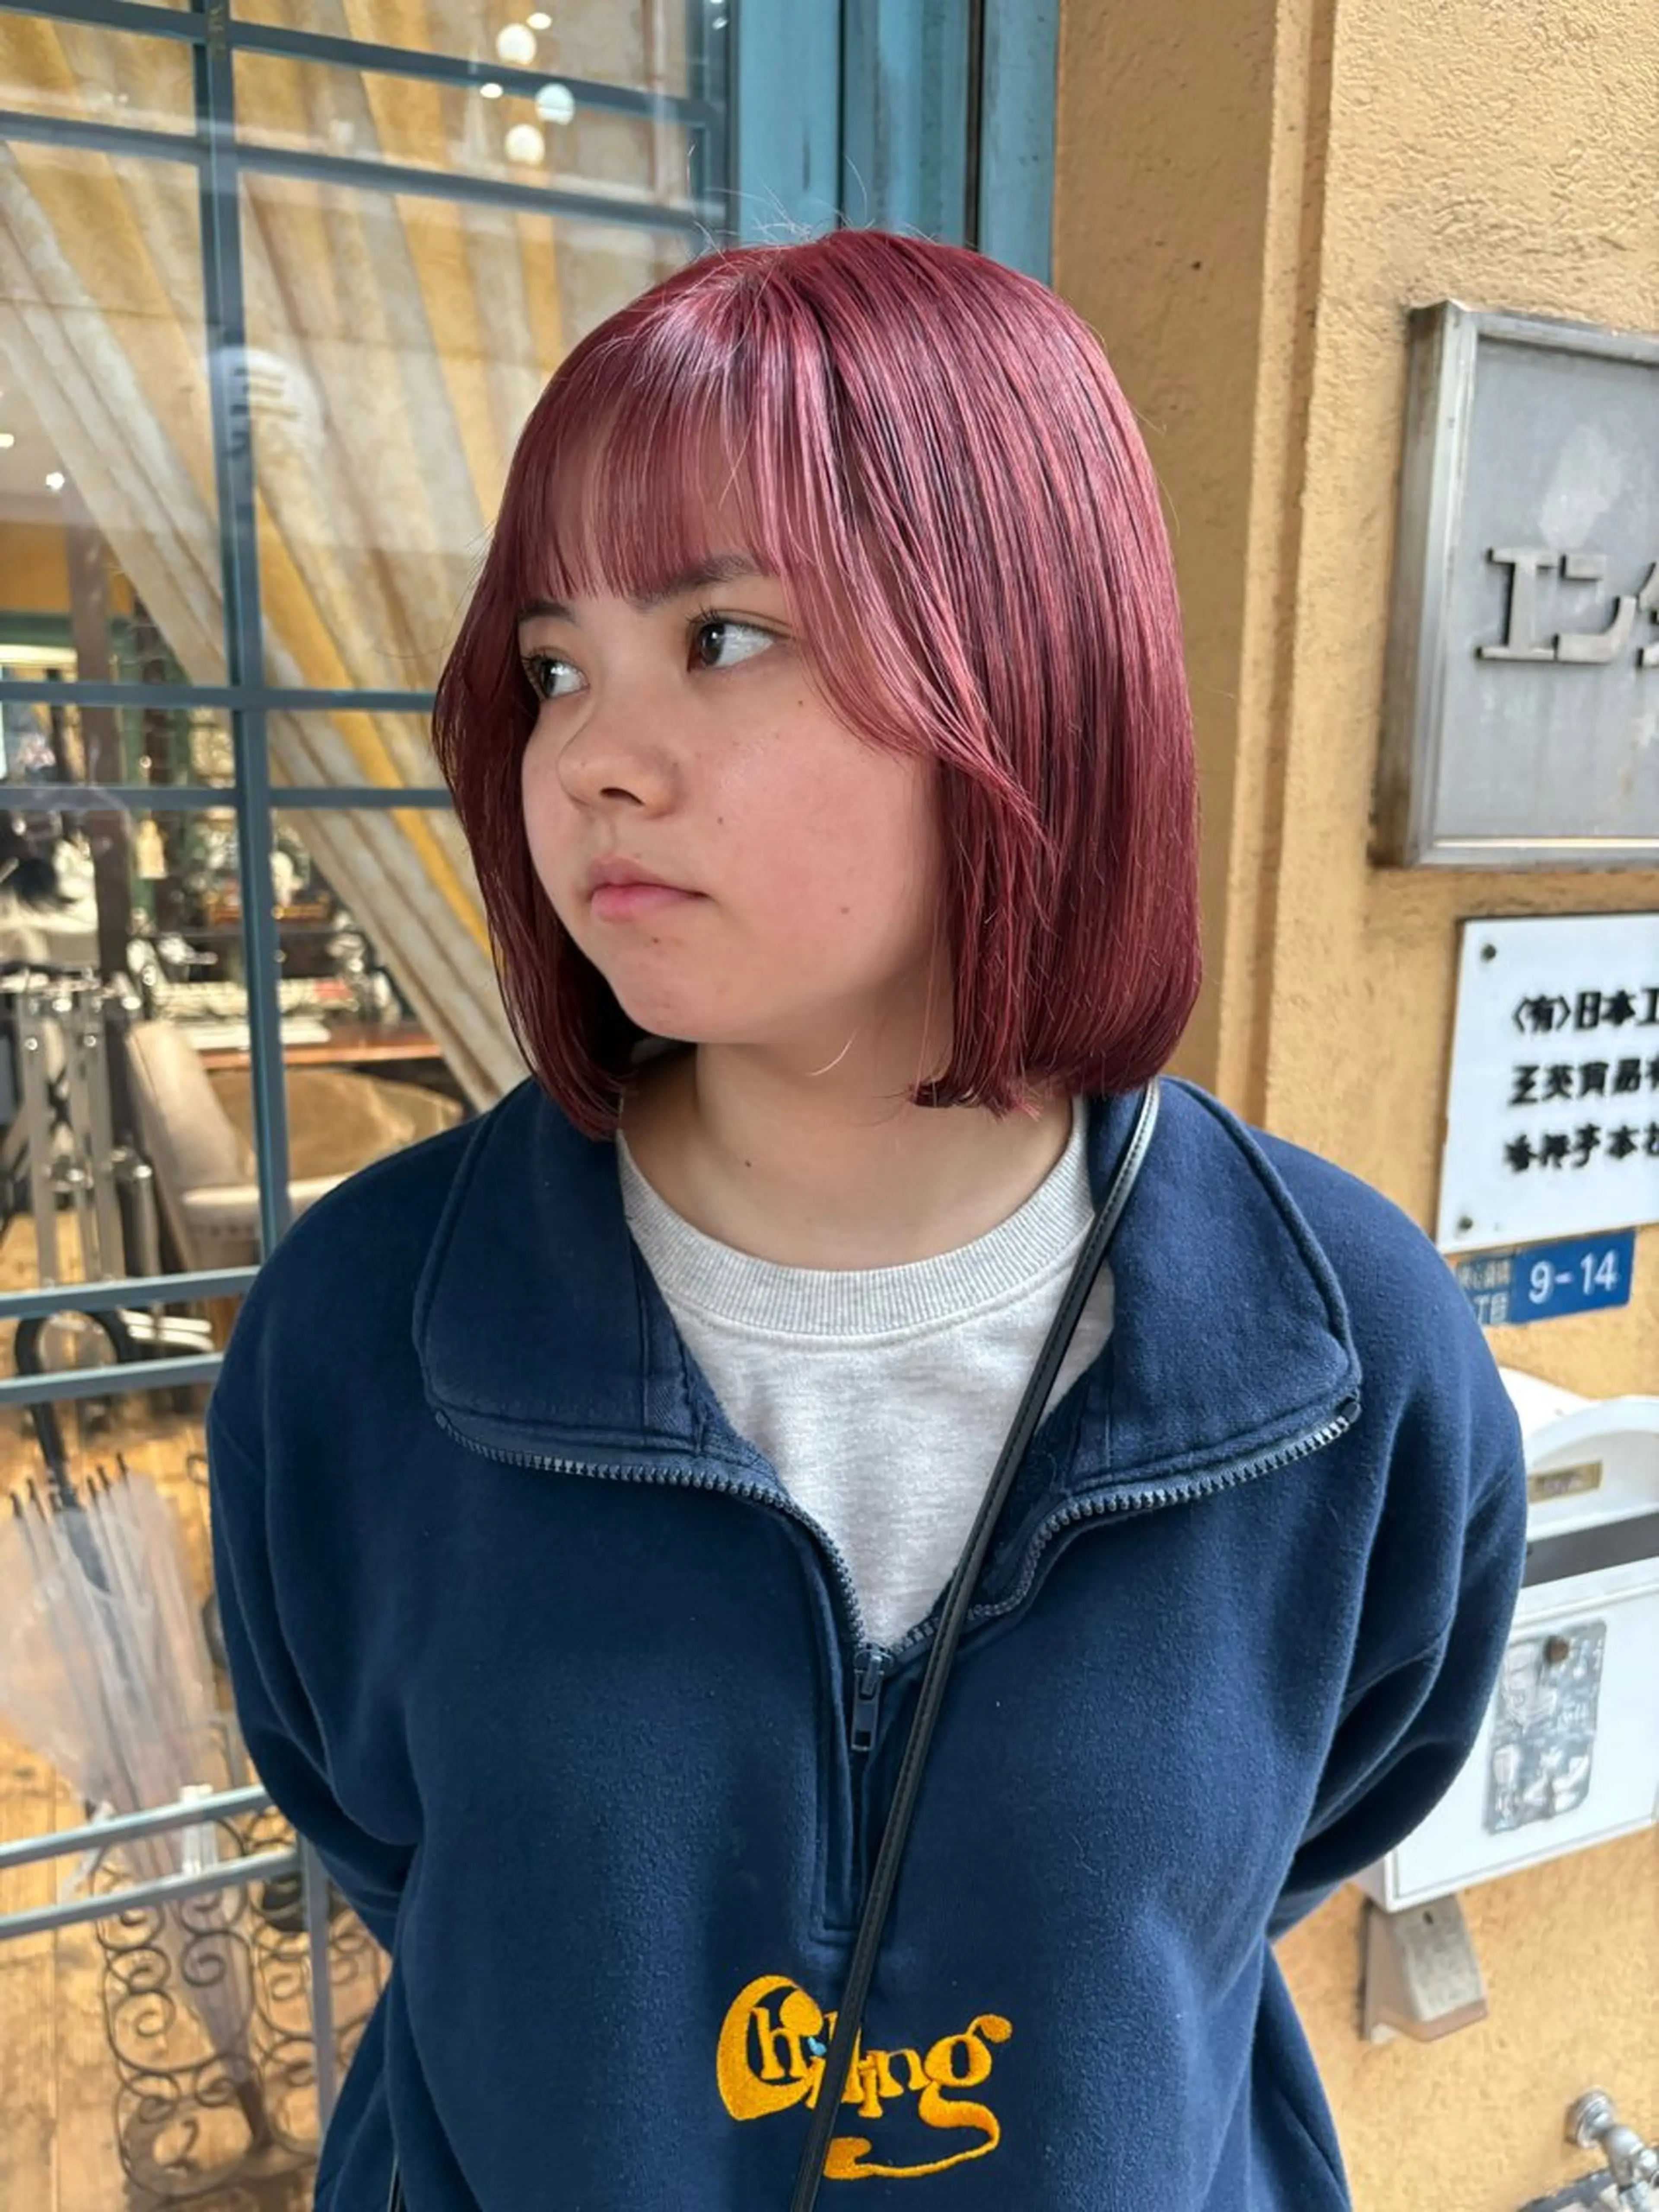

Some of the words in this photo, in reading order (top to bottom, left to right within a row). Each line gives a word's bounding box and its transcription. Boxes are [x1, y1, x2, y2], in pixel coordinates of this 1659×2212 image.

[1477, 546, 1659, 668] エン
[1529, 1250, 1621, 1304] 9-14
[716, 1975, 1012, 2180] Chiling
